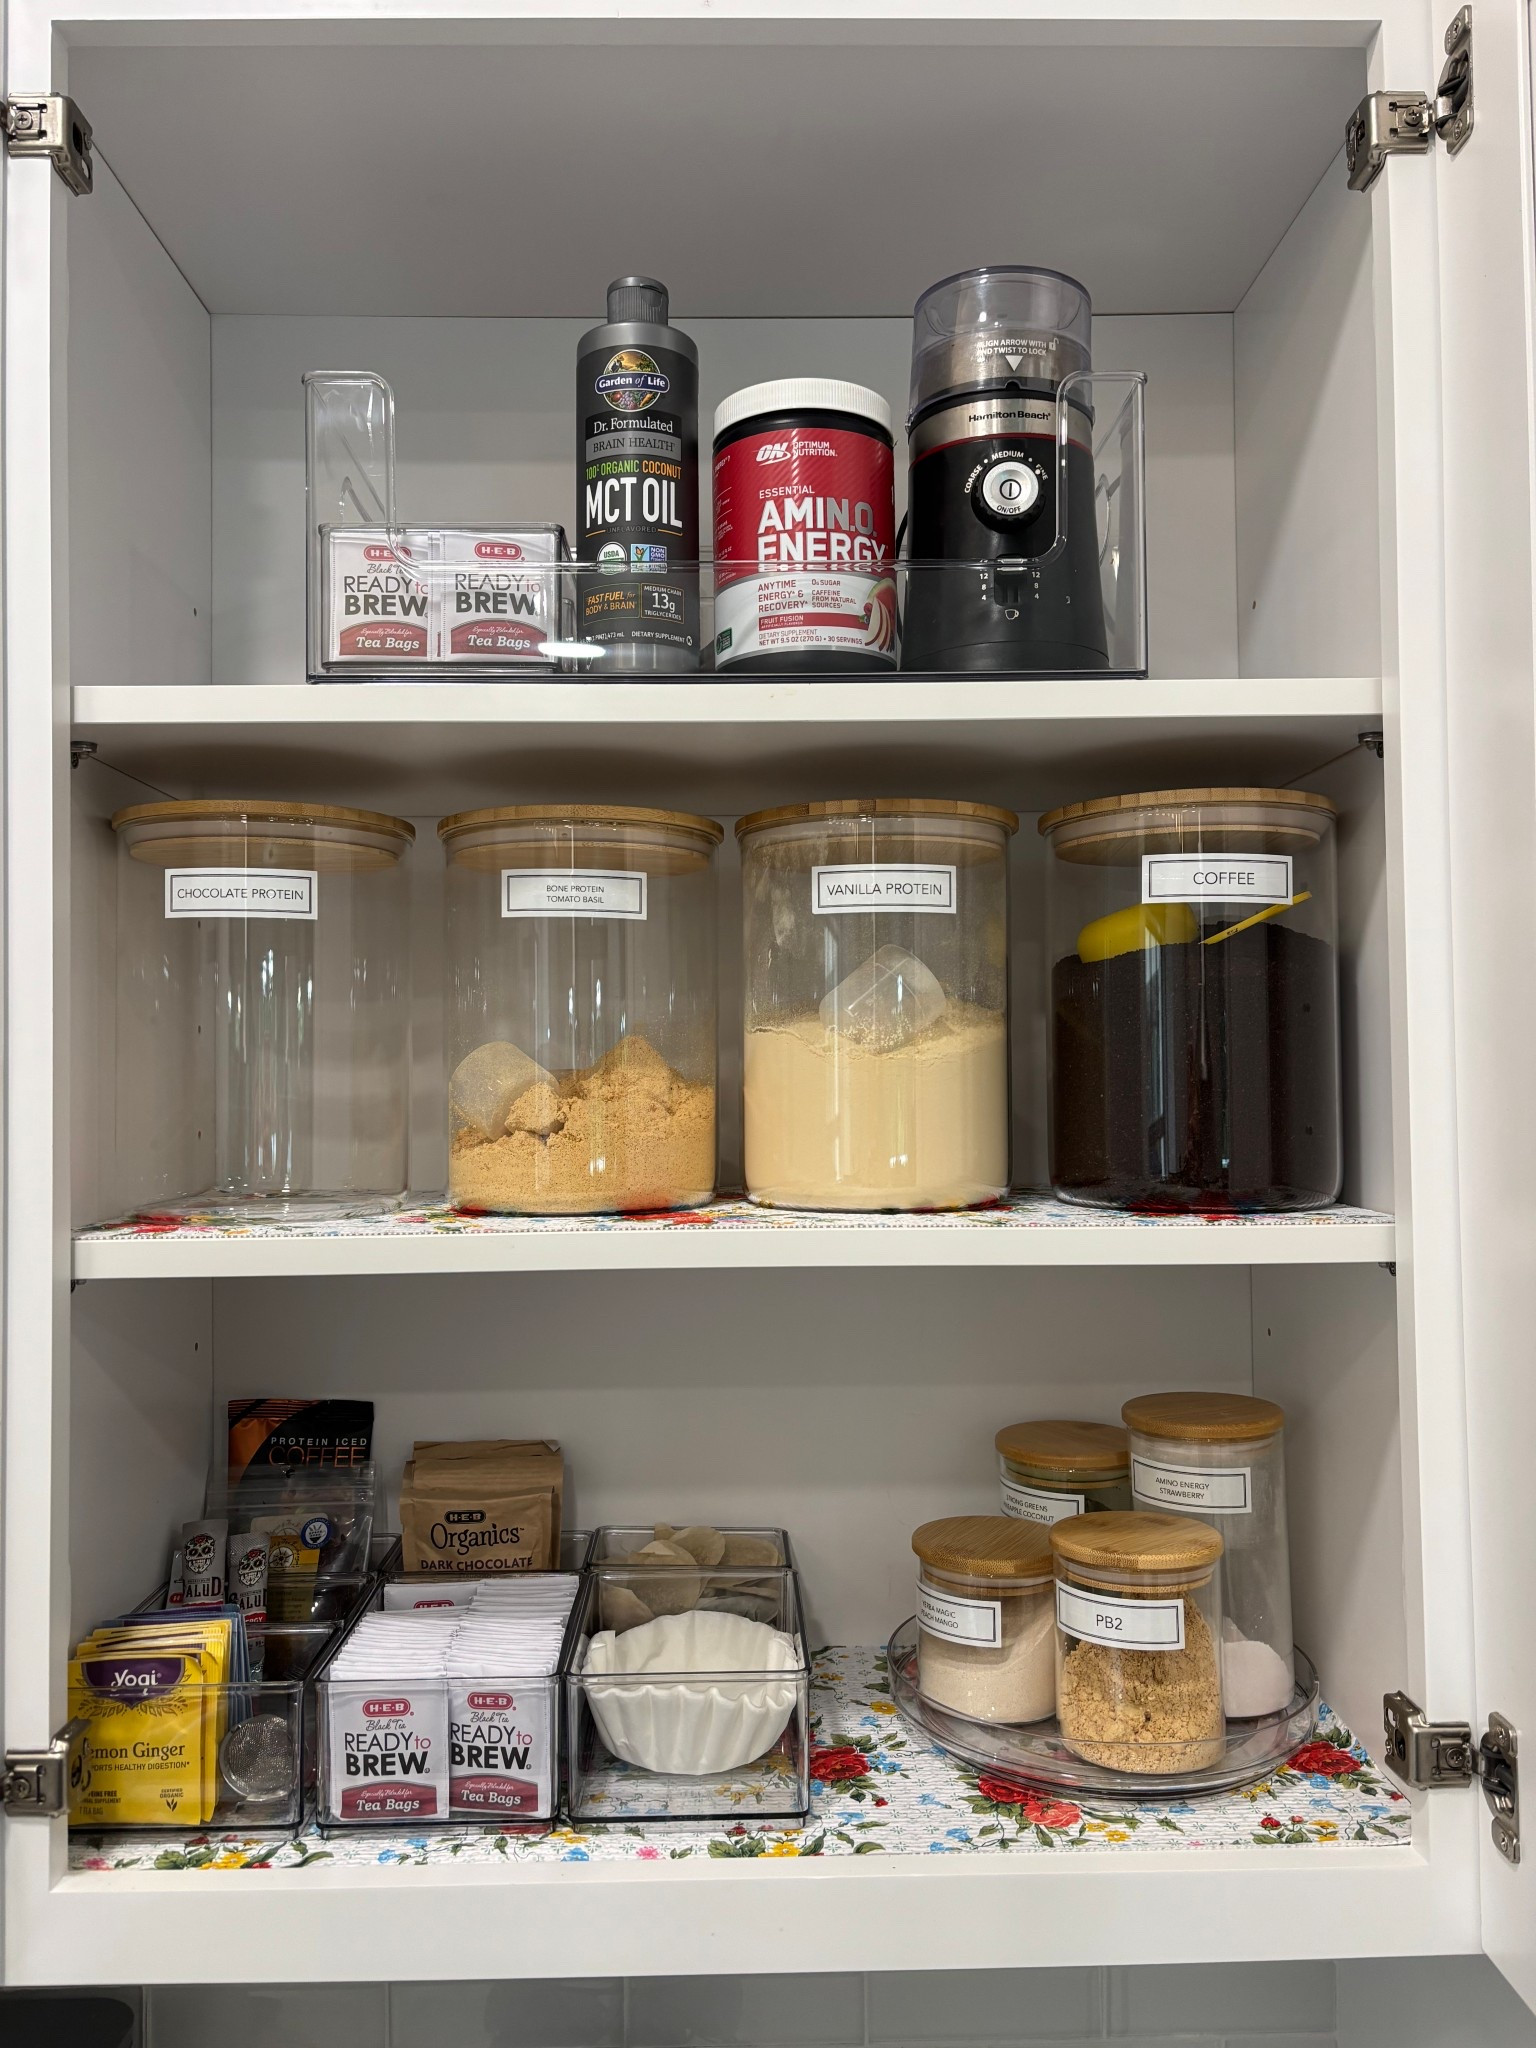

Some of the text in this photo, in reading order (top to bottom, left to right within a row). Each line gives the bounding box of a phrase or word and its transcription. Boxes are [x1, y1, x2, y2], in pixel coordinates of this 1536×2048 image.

[1000, 339, 1028, 347] ARROW
[1029, 340, 1046, 348] WITH
[994, 346, 1016, 354] TWIST
[1017, 346, 1028, 354] TO
[1028, 348, 1047, 356] LOCK
[599, 374, 666, 388] Garden of Life
[968, 410, 1050, 422] Hamilton Beach
[593, 417, 673, 434] Dr. Formulated
[593, 438, 673, 453] BRAIN HEALTH
[756, 441, 830, 462] ON OPTIMUM
[991, 450, 1024, 462] MEDIUM
[600, 459, 640, 476] ORGANIC
[642, 460, 682, 480] COCONUT
[1036, 463, 1049, 481] FINE
[964, 463, 983, 494] COARSE
[759, 485, 815, 499] ESSENTIAL
[586, 476, 683, 529] MCT OIL
[996, 504, 1022, 515] ON/OFF
[606, 526, 657, 534] UNFLAVORED
[603, 550, 620, 559] USDA
[757, 531, 886, 571] ENERGY
[367, 563, 392, 574] Black
[1031, 571, 1041, 579] 12
[455, 573, 525, 592] READY
[820, 579, 841, 587] SUGAR
[980, 572, 989, 580] 12
[344, 575, 413, 594] READY
[643, 585, 682, 597] MEDIUM CHAIN
[758, 579, 797, 593] ANYTIME
[588, 591, 636, 606] FAST FUEL for
[797, 590, 804, 598] &
[830, 596, 857, 605] NATURAL
[344, 594, 429, 617] BREW
[455, 591, 536, 616] BREW
[585, 604, 603, 616] BODY
[609, 601, 636, 611] BRAIN
[652, 592, 676, 614] 13g
[644, 609, 682, 621] TRIGLYCERIDES
[760, 614, 804, 626] FRUIT FUSION
[631, 630, 686, 643] DIETARY SUPPLEMENT
[758, 628, 818, 640] DIETARY SUPPLEMENT
[758, 639, 770, 647] NET
[771, 637, 780, 645] WT
[799, 635, 814, 643] (270
[835, 636, 863, 645] SERVINGS
[355, 636, 420, 652] Tea Bags
[467, 634, 531, 651] Tea Bags
[1193, 871, 1255, 886] COFFEE
[177, 888, 304, 900] CHOCOLATE PROTEIN
[546, 884, 605, 893] BONE PROTEIN
[826, 882, 942, 896] VANILLA PROTEIN
[546, 895, 605, 904] TOMATO BASIL
[271, 1437, 367, 1446] PROTEIN ICED
[268, 1446, 366, 1468] COFFEE
[1155, 1476, 1210, 1491] AMINO ENERGY
[1159, 1487, 1205, 1500] STRAWBERRY
[1024, 1501, 1048, 1513] GREENS
[1022, 1510, 1054, 1522] COCONUT
[430, 1522, 520, 1556] Organics
[420, 1556, 533, 1571] DARK CHOCOLATE
[935, 1608, 956, 1619] MAGIC
[934, 1616, 959, 1629] MANGO
[1095, 1614, 1123, 1631] PB2
[469, 1711, 510, 1724] Black Tea
[365, 1718, 407, 1732] Black Tea
[450, 1722, 533, 1746] READY to
[344, 1731, 432, 1753] READY to
[132, 1741, 186, 1761] Ginger
[450, 1742, 530, 1770] BREW
[114, 1763, 145, 1771] HEALTHY
[345, 1751, 429, 1777] BREW
[103, 1790, 118, 1798] FREE
[460, 1789, 522, 1807] Tea Bags
[356, 1798, 420, 1812] Tea Bags
